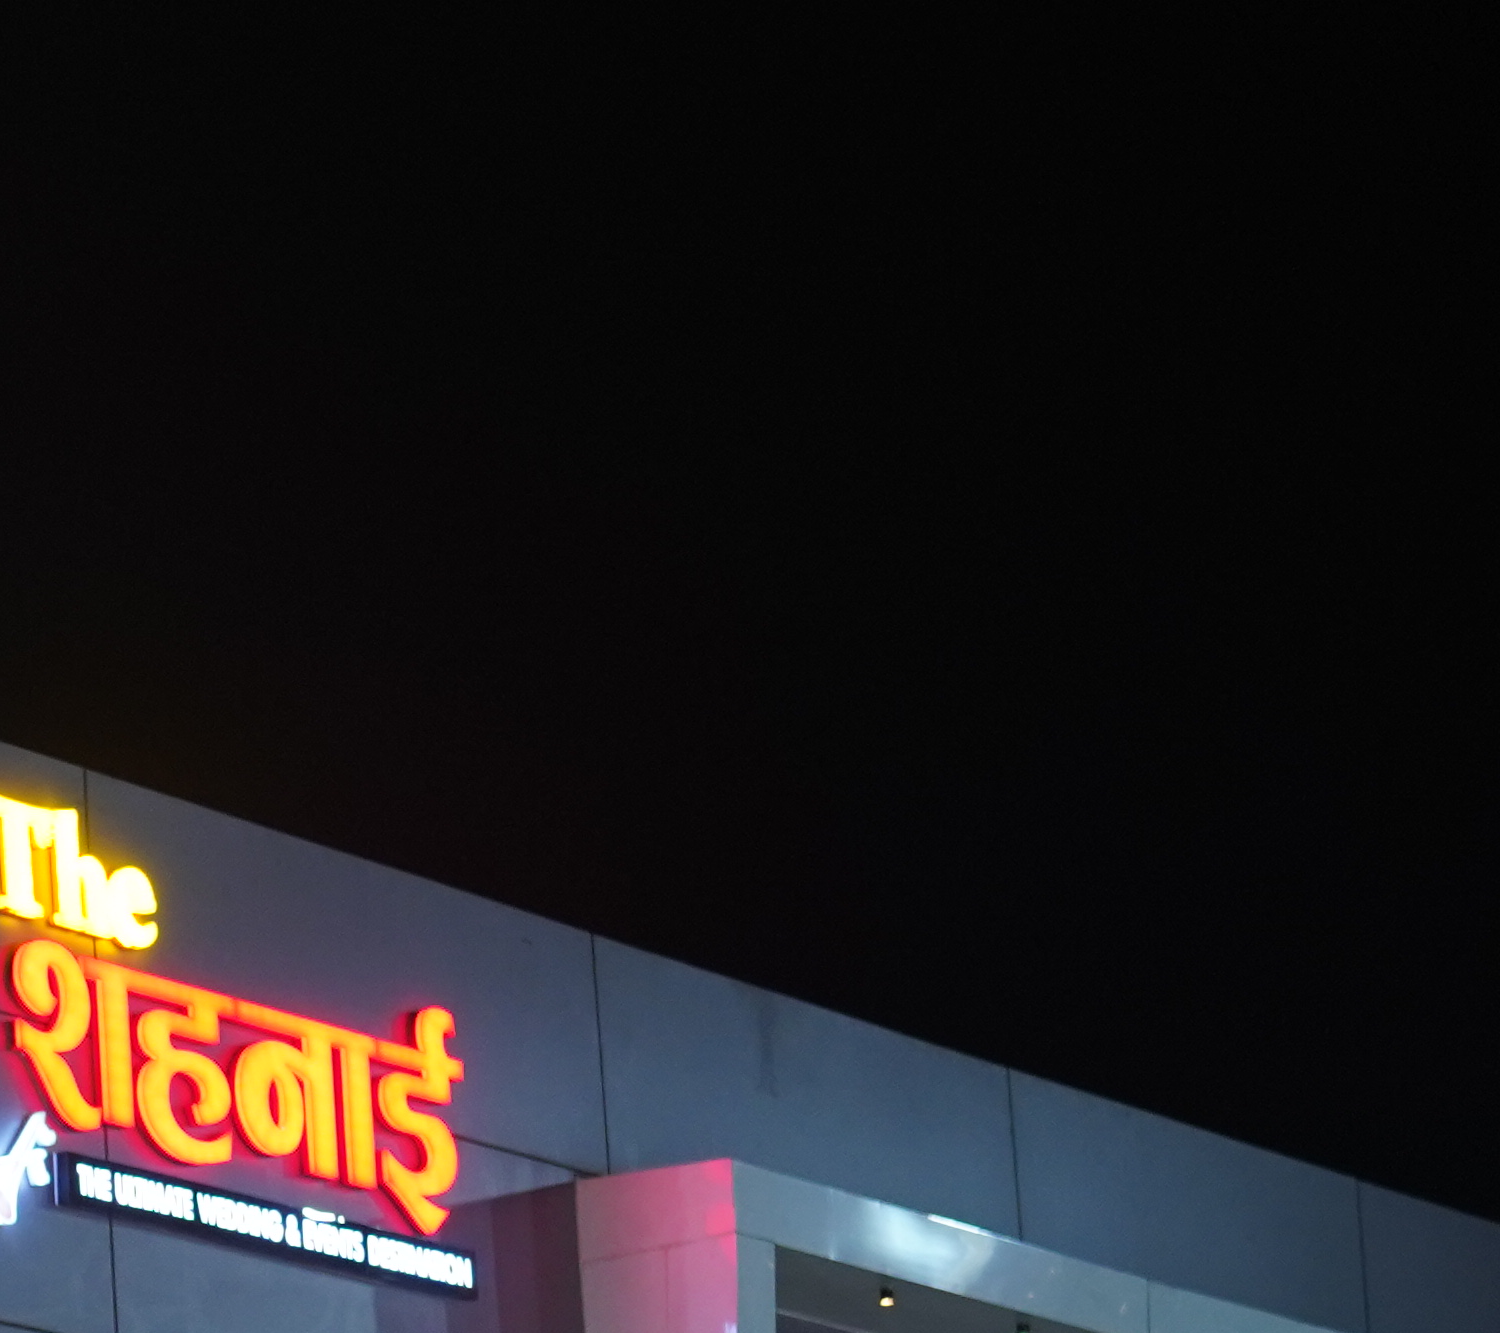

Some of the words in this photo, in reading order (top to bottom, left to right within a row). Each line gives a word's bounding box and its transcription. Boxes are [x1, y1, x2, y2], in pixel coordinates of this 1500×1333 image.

[8, 938, 466, 1236] शहनाई
[76, 1162, 113, 1202] THE
[114, 1172, 195, 1221] ULTIMATE
[196, 1192, 285, 1243] WEDDING
[285, 1213, 302, 1247] &
[302, 1218, 365, 1263] EVENTS
[367, 1234, 473, 1289] DESTINATION
